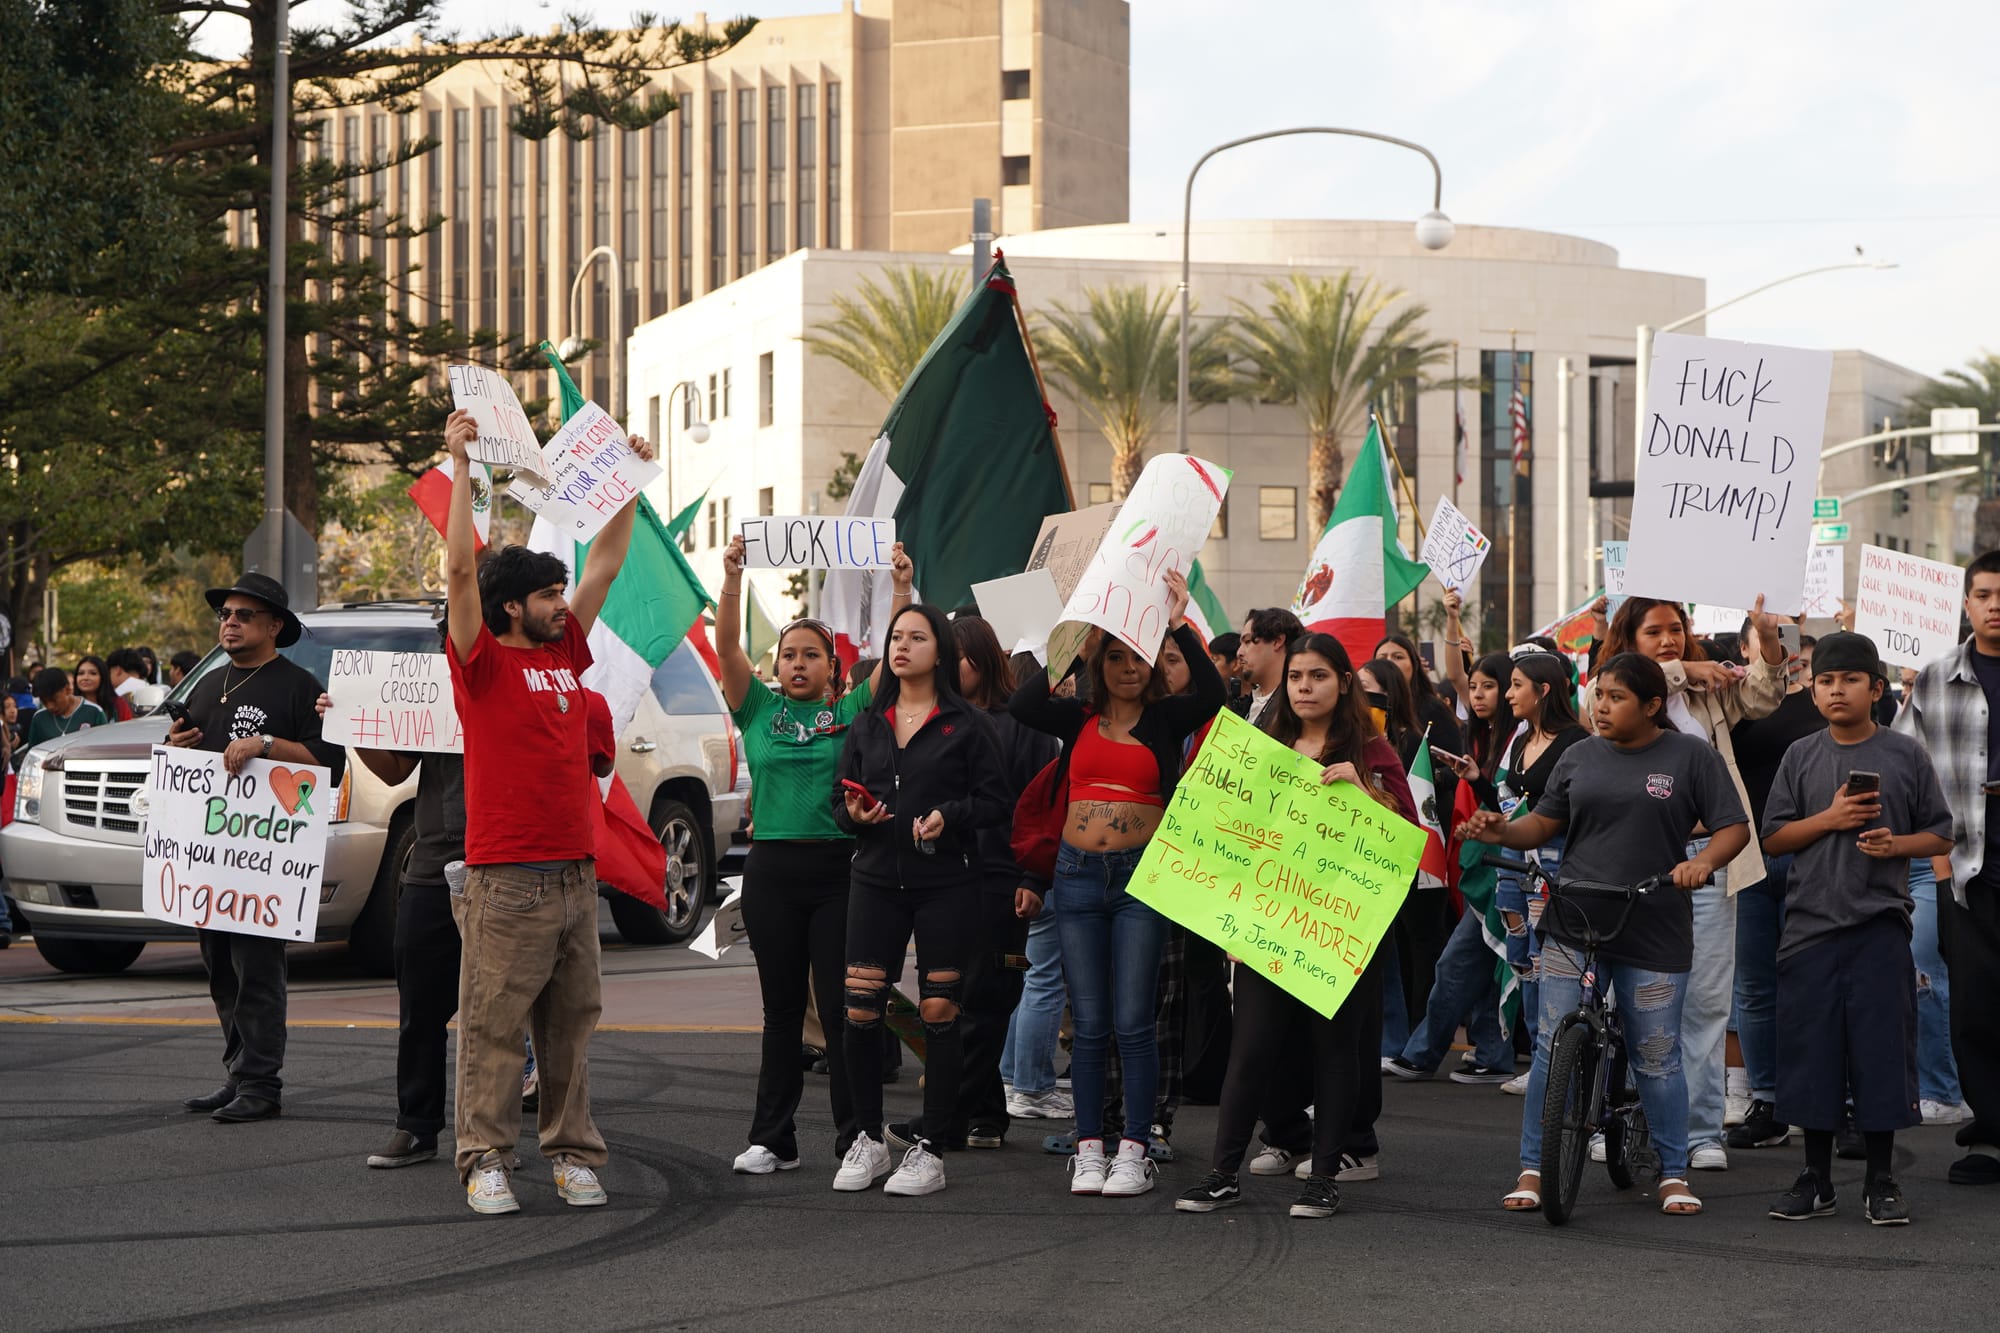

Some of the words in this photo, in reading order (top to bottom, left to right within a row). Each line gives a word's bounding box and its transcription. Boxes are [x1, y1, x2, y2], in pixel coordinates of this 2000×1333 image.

[1676, 358, 1781, 422] FUCK
[570, 440, 596, 461] MI
[558, 470, 599, 506] YOUR
[590, 438, 633, 475] MOM'S
[587, 471, 637, 517] HOE
[1662, 480, 1791, 541] TRUMP!
[741, 520, 830, 567] FUCK
[1424, 539, 1438, 566] NO
[1432, 501, 1456, 543] HUMAN
[1606, 546, 1621, 562] MI
[1866, 552, 1892, 571] PARA
[1897, 560, 1917, 578] MIS
[1920, 565, 1959, 588] PADRES
[1862, 576, 1882, 592] QUE
[1887, 582, 1927, 606] VINIERON
[1934, 598, 1952, 614] SIN
[1860, 598, 1887, 617] NADA
[1892, 607, 1899, 623] Y
[1920, 615, 1953, 637] DIERON
[1883, 628, 1920, 657] TODO
[334, 651, 373, 676] BORN
[390, 651, 432, 678] FROM
[237, 705, 268, 721] ORANGE
[381, 681, 439, 703] CROSSED
[234, 711, 265, 727] COUNTY
[350, 708, 435, 747] #VIVA
[1210, 714, 1257, 770] Este
[1270, 763, 1320, 797] versos
[224, 773, 257, 799] no
[204, 796, 308, 843] Border
[1178, 785, 1200, 810] tu
[1214, 800, 1284, 846] Sangre
[1292, 842, 1307, 860] A
[1317, 858, 1383, 895] garrados
[1269, 788, 1281, 814] Y
[1286, 799, 1308, 825] los
[1316, 822, 1346, 844] que
[1353, 836, 1401, 877] llevan
[184, 842, 215, 872] you
[223, 848, 273, 876] need
[281, 858, 320, 880] our
[1166, 814, 1183, 837] De
[1192, 829, 1205, 848] la
[1214, 839, 1252, 867] Mano
[1256, 859, 1361, 921] CHINGUEN
[1156, 838, 1219, 889] Todos
[1228, 881, 1242, 902] A
[1252, 893, 1281, 918] SU
[1280, 905, 1372, 976] MADRE!
[1245, 923, 1288, 957] Jenni
[1293, 949, 1338, 988] Rivera
